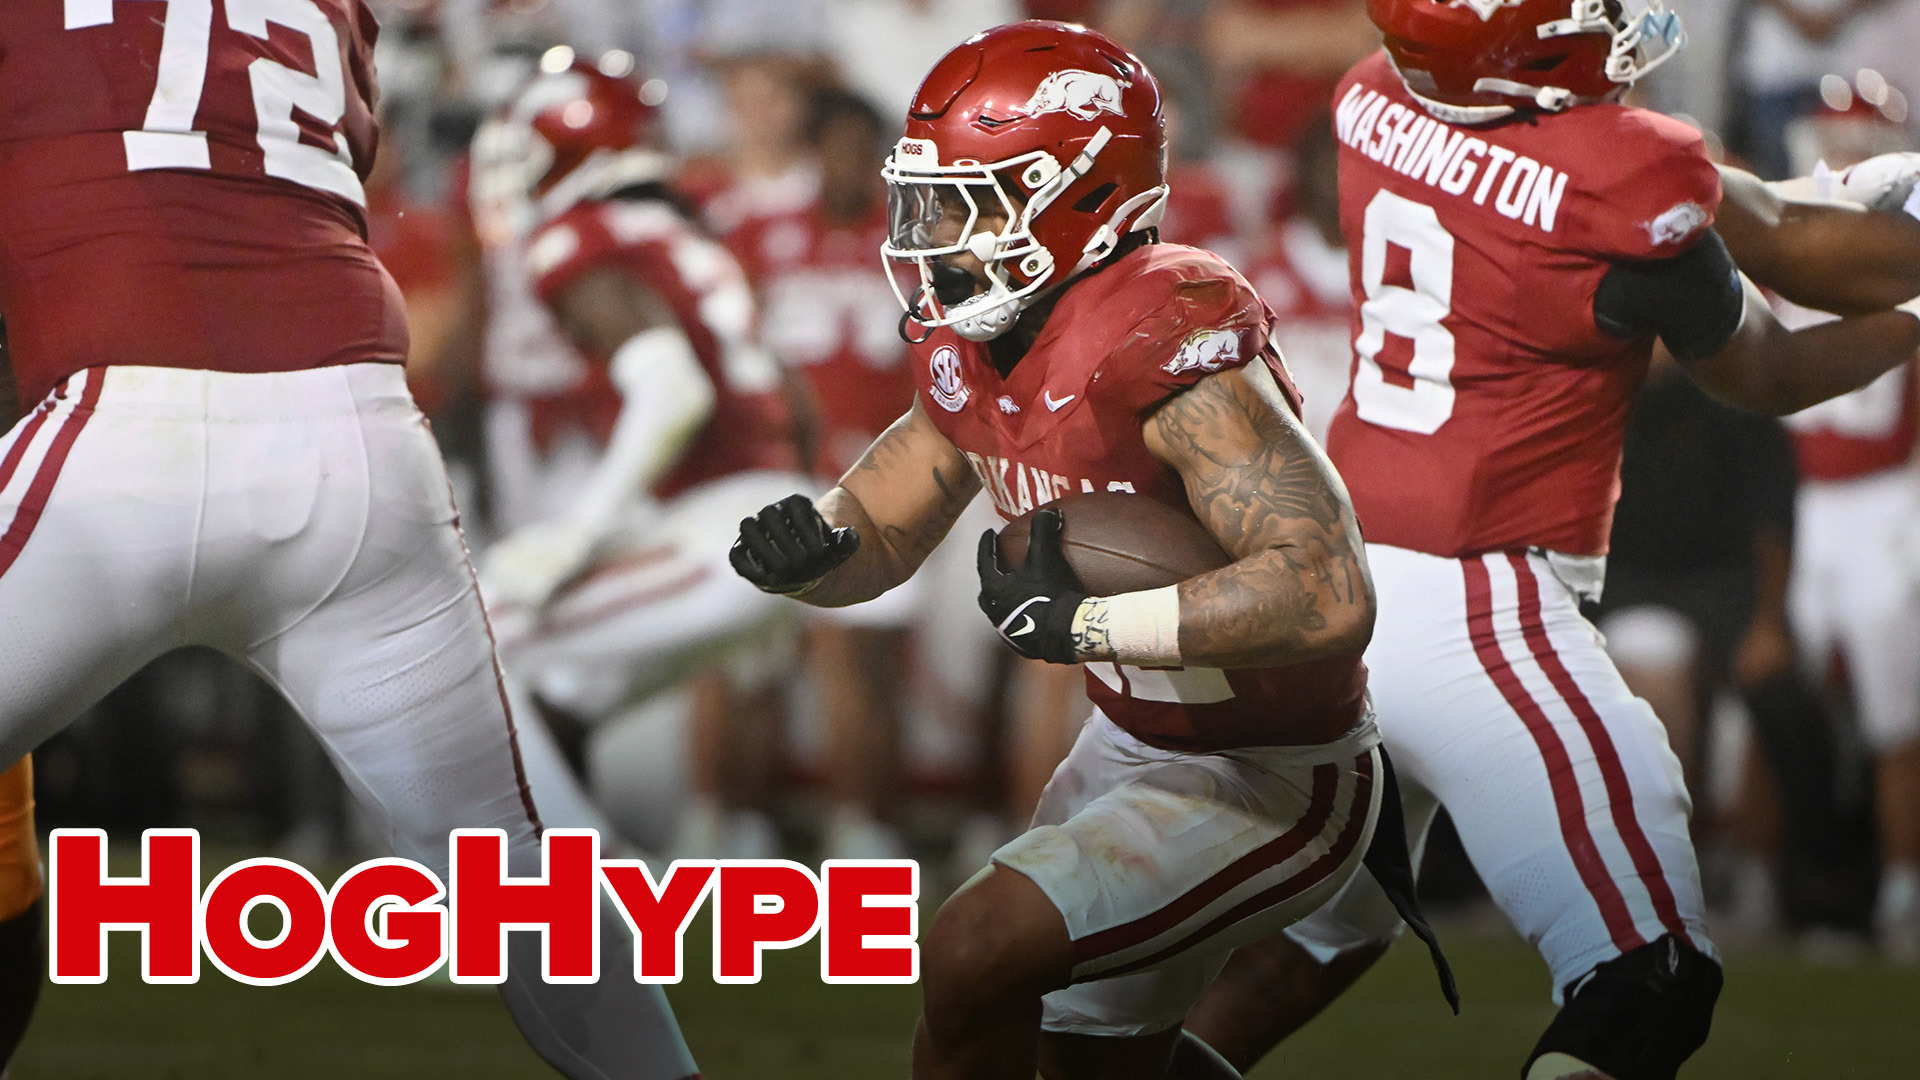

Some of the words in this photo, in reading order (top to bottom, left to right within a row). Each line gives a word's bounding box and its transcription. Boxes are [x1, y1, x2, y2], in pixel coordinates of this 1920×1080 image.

[64, 0, 367, 208] 72
[901, 142, 923, 155] HOGS
[1336, 83, 1568, 233] WASHINGTON
[931, 348, 962, 396] SEC
[1353, 188, 1455, 435] 8
